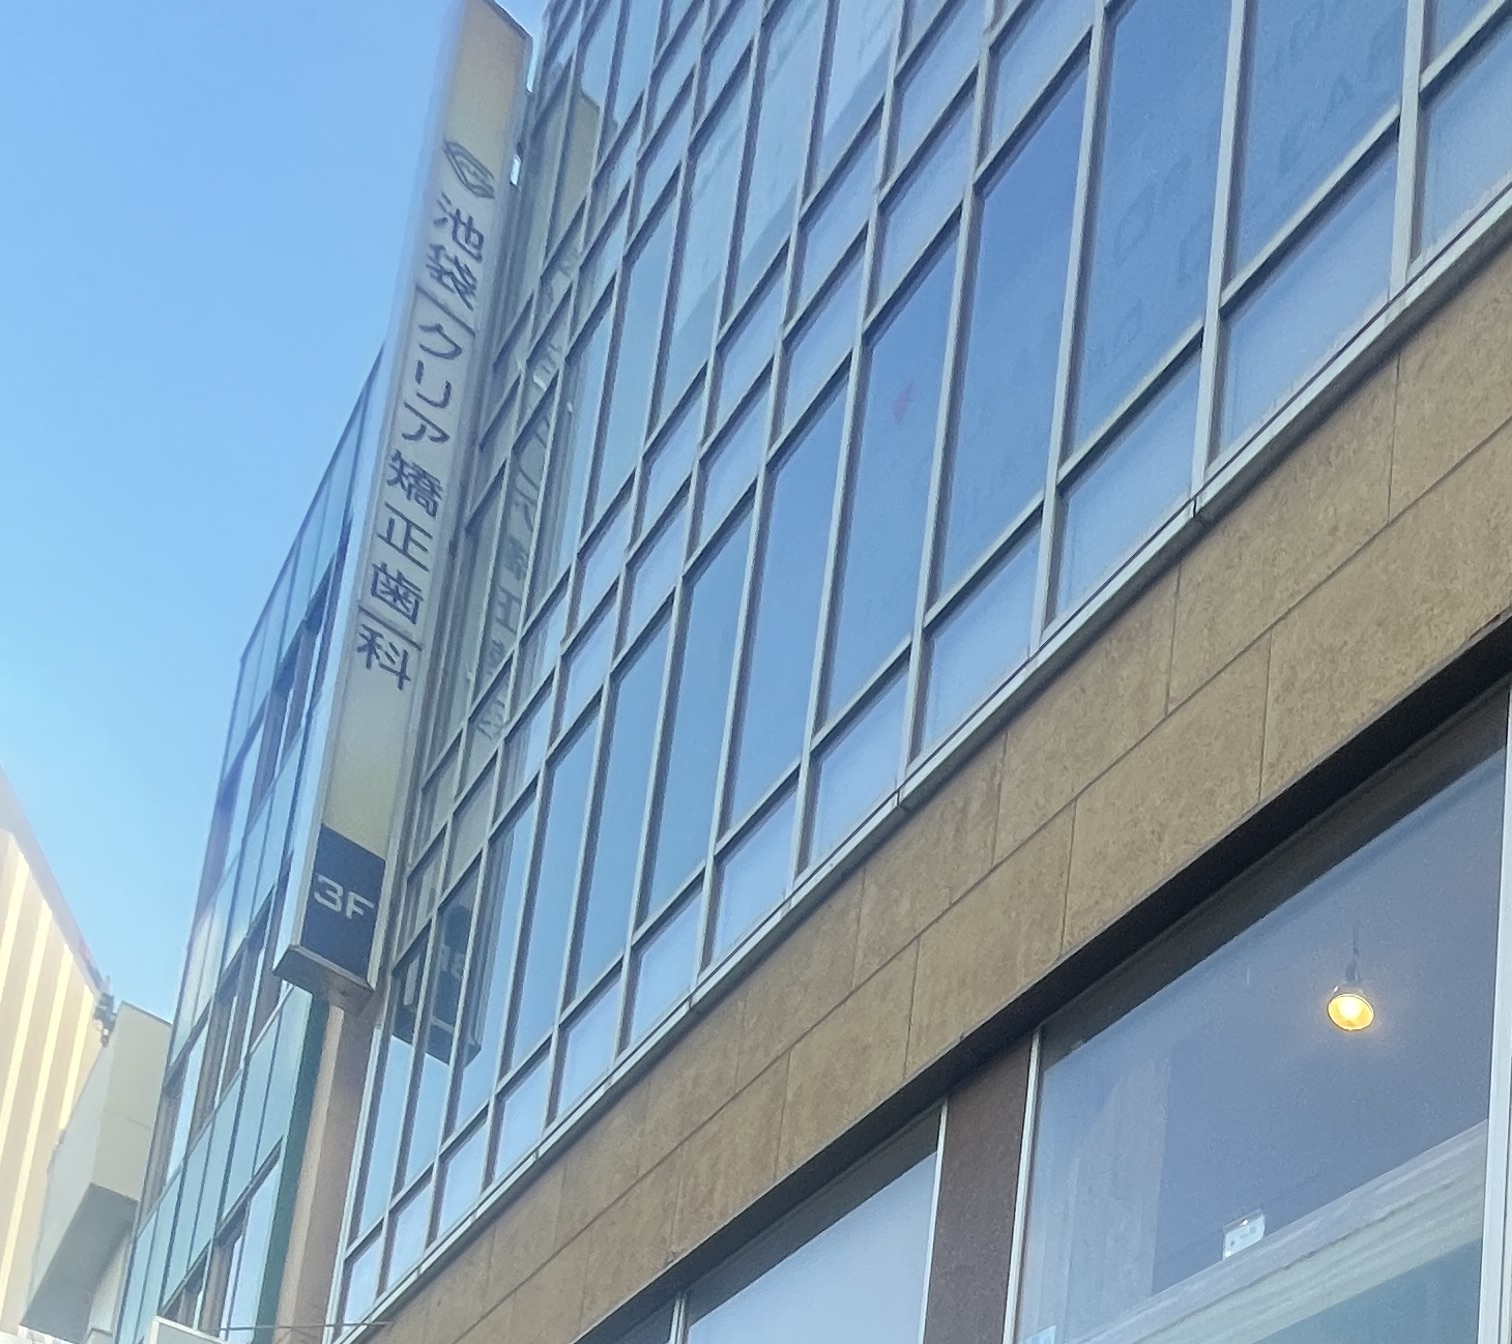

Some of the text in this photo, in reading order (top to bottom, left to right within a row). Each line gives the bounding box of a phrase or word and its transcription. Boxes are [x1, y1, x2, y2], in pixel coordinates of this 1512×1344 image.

[357, 191, 484, 691] 池袋クリア矯正歯科
[314, 873, 375, 919] 3F
